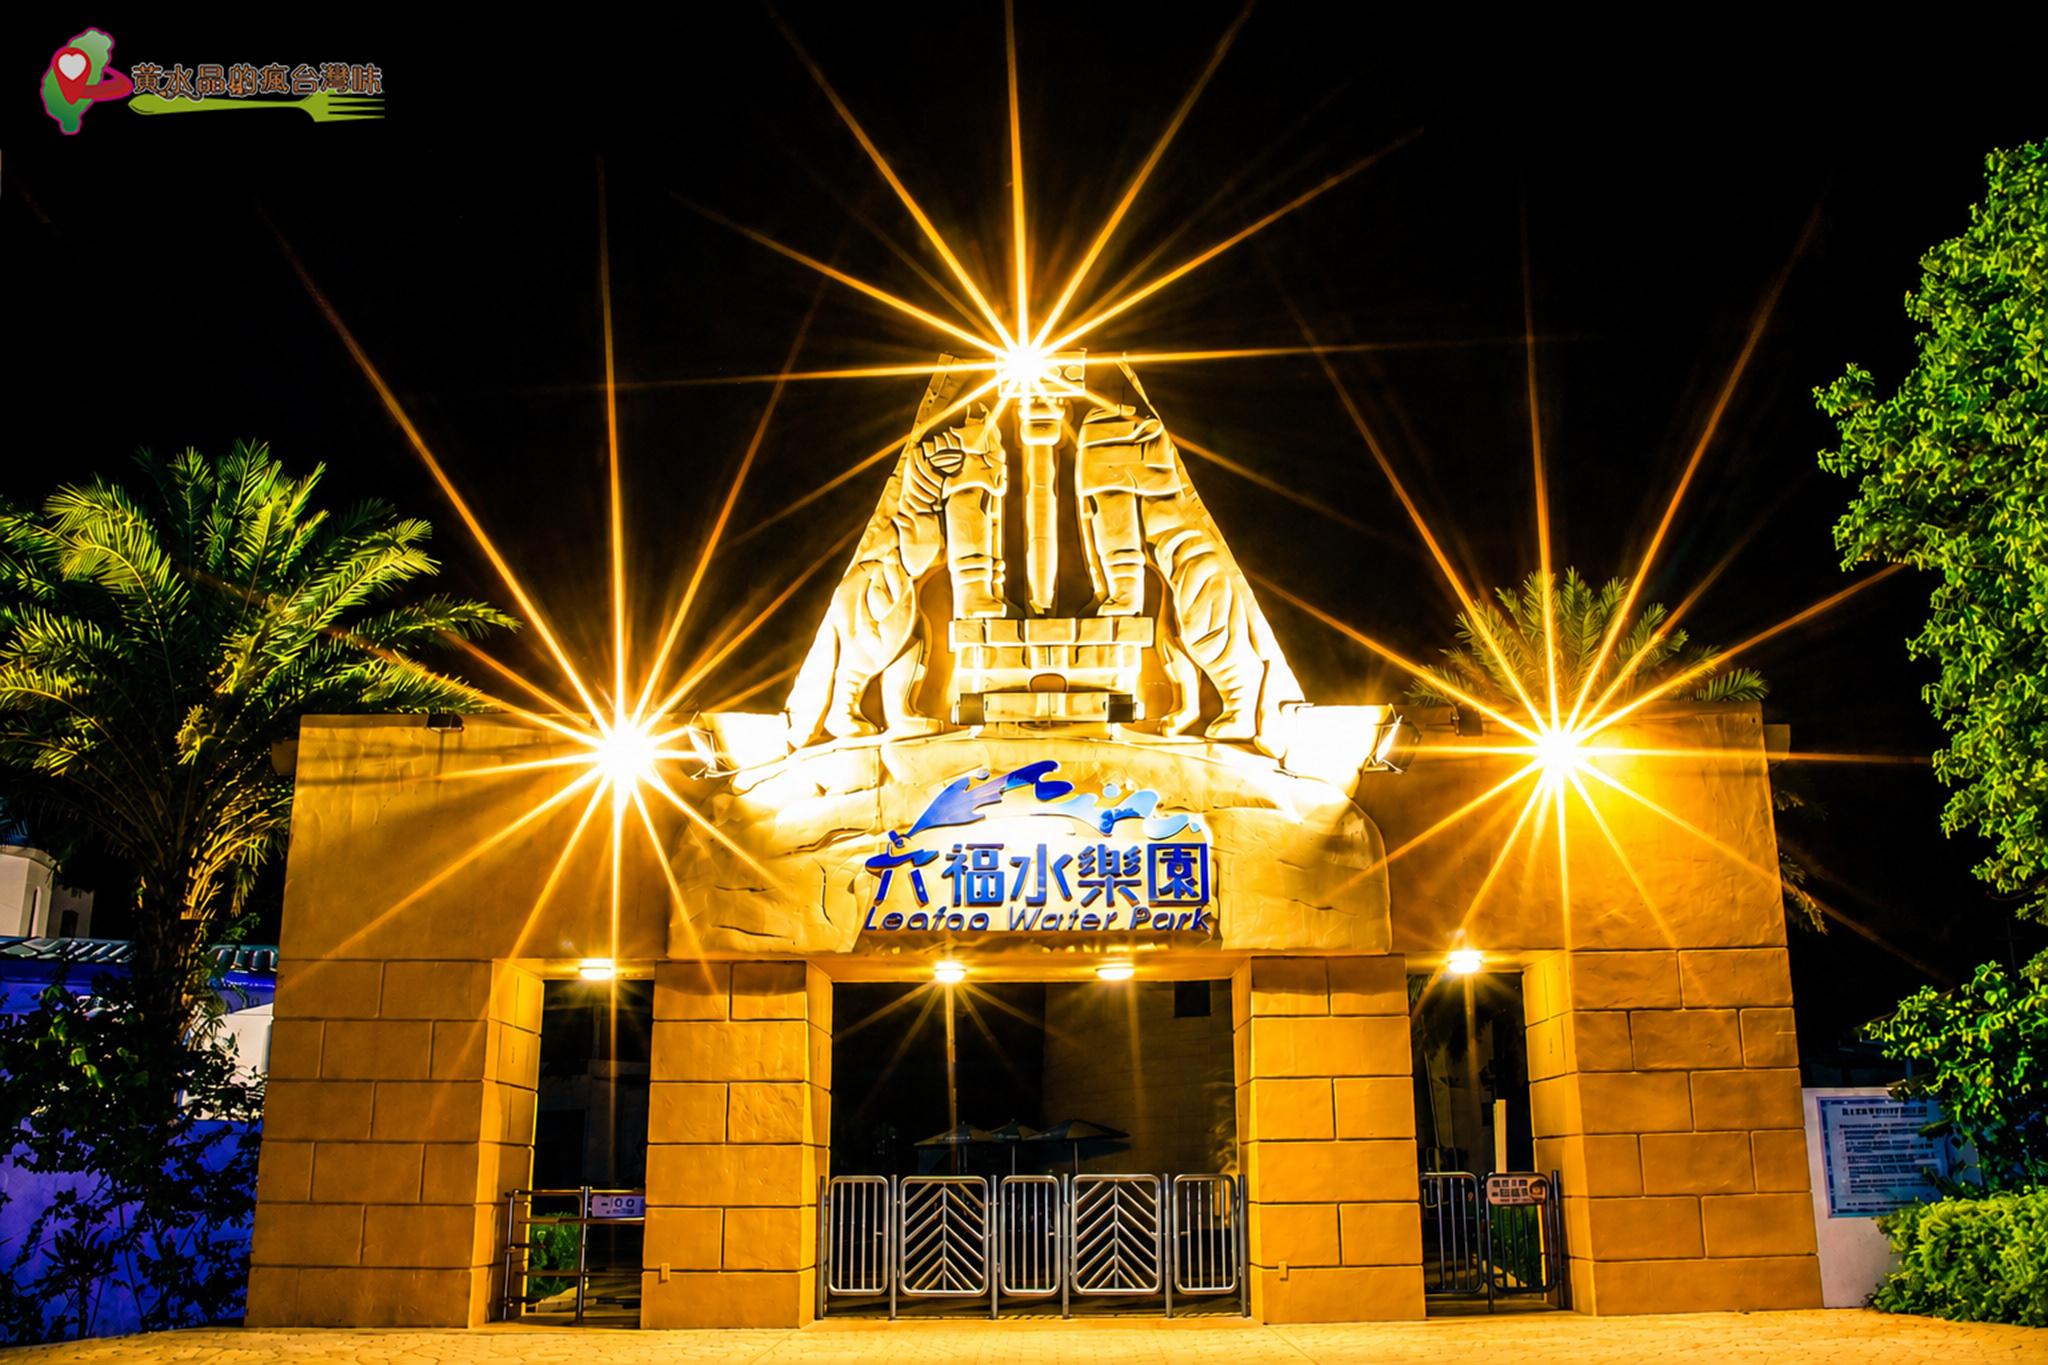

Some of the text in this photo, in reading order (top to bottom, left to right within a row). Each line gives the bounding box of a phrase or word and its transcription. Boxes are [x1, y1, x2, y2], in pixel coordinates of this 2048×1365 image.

[865, 830, 1211, 907] 六福水樂園
[1008, 906, 1118, 931] Water
[1129, 906, 1212, 931] Park
